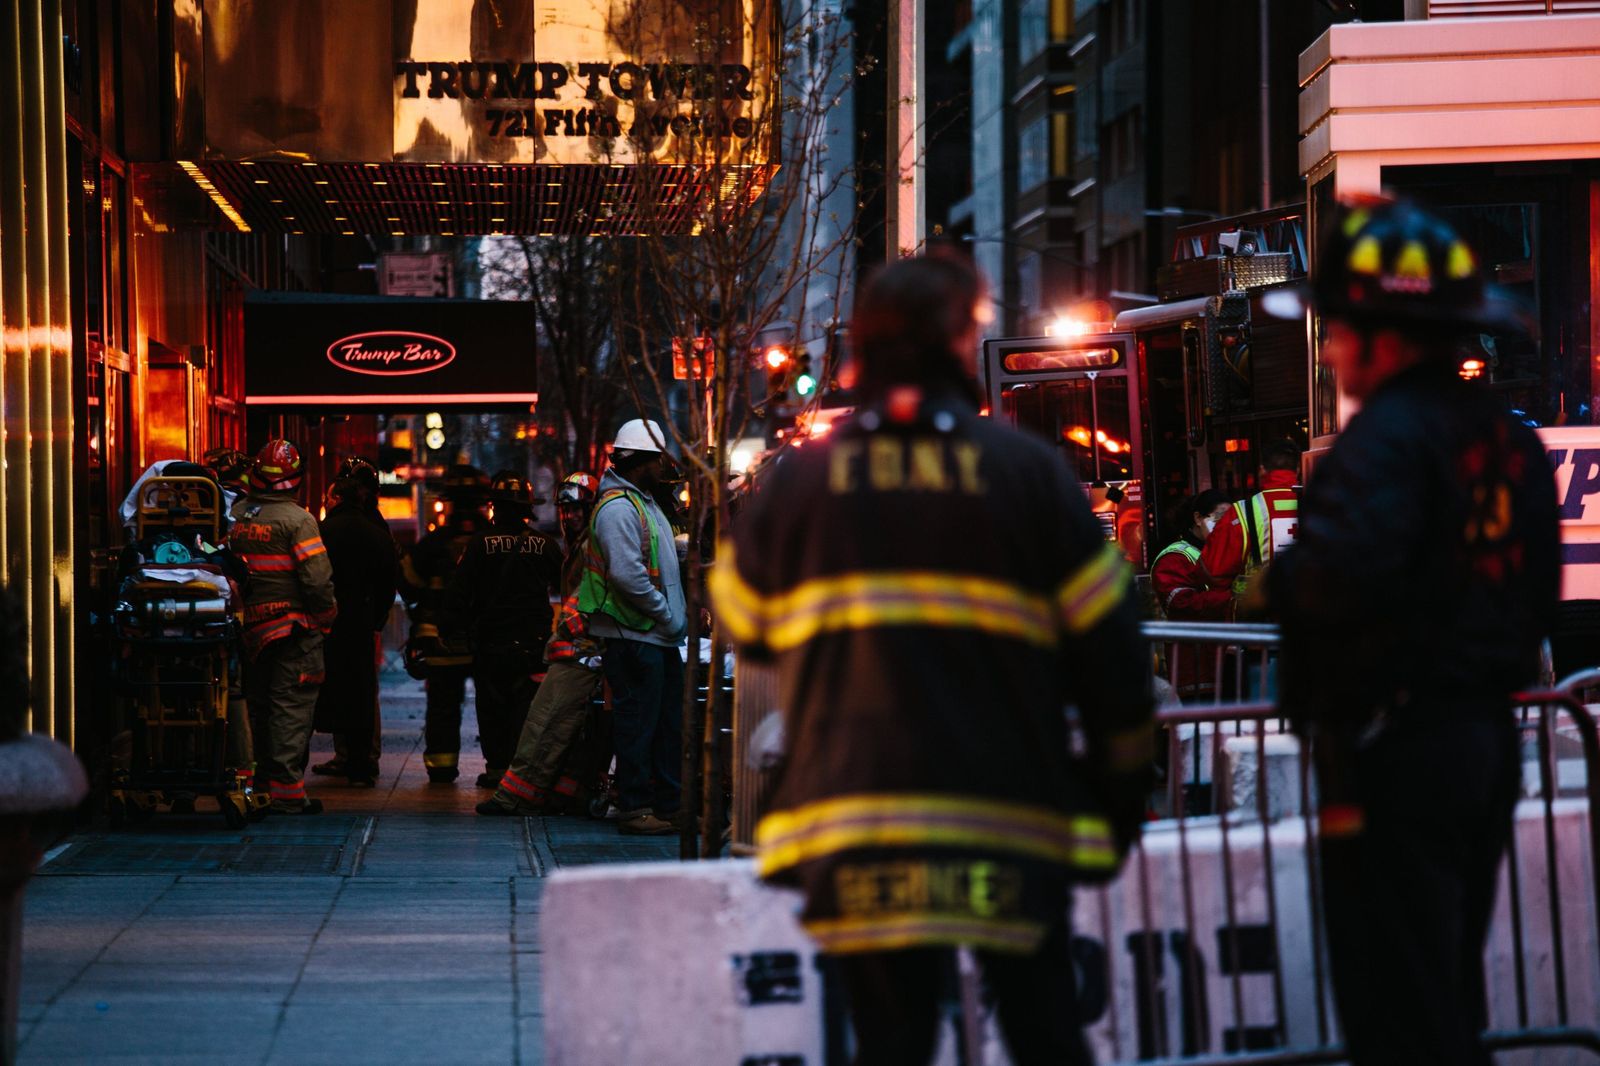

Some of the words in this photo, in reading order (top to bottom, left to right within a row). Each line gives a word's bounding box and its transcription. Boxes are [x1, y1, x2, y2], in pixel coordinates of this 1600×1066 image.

[395, 62, 568, 99] TRUMP
[579, 61, 754, 101] TOWER
[486, 109, 538, 137] 721
[543, 107, 620, 137] Fifth
[340, 342, 402, 365] Trump
[402, 343, 444, 361] Bar
[1549, 449, 1600, 520] P
[484, 535, 546, 555] FDNY
